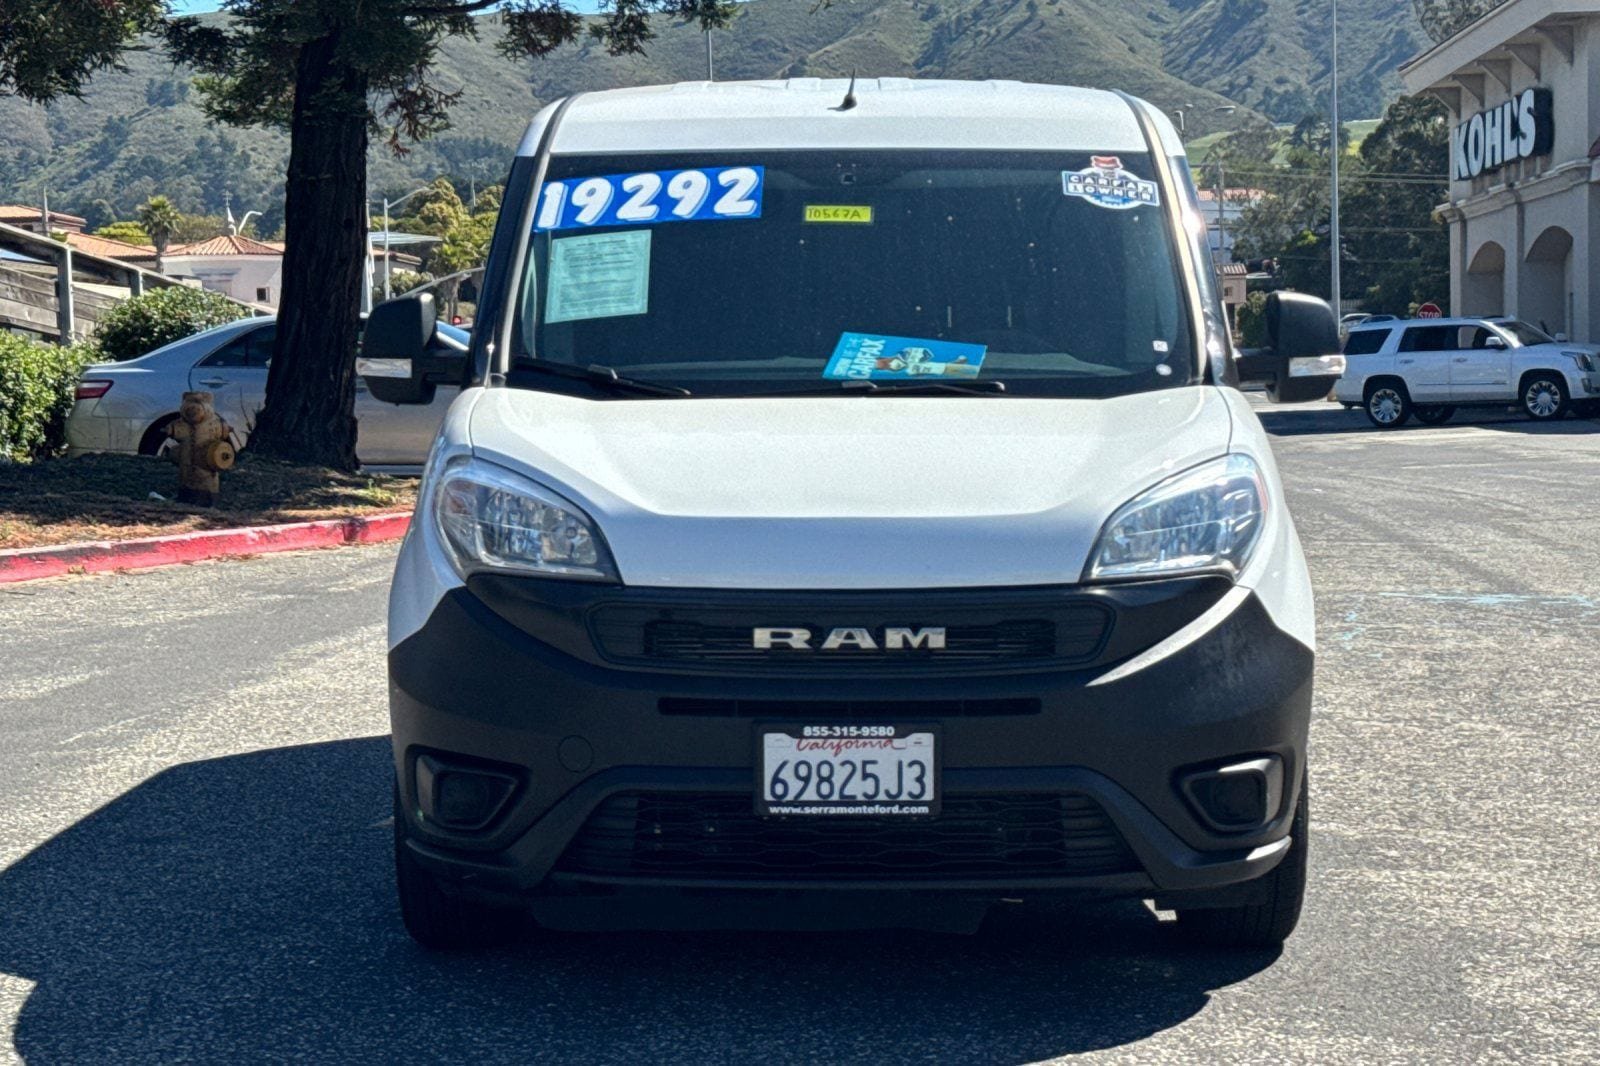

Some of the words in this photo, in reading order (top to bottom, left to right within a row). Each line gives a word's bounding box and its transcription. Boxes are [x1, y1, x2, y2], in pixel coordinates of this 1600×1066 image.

[1453, 88, 1536, 181] KOHL'S
[537, 167, 760, 229] 19292
[1418, 311, 1441, 319] STOP
[847, 338, 886, 380] CARFAX
[753, 627, 947, 649] RAM
[802, 725, 896, 737] 855-315-9580
[796, 738, 907, 758] California
[769, 759, 927, 801] 69825J3
[768, 804, 930, 815] www.serramonteford.com
